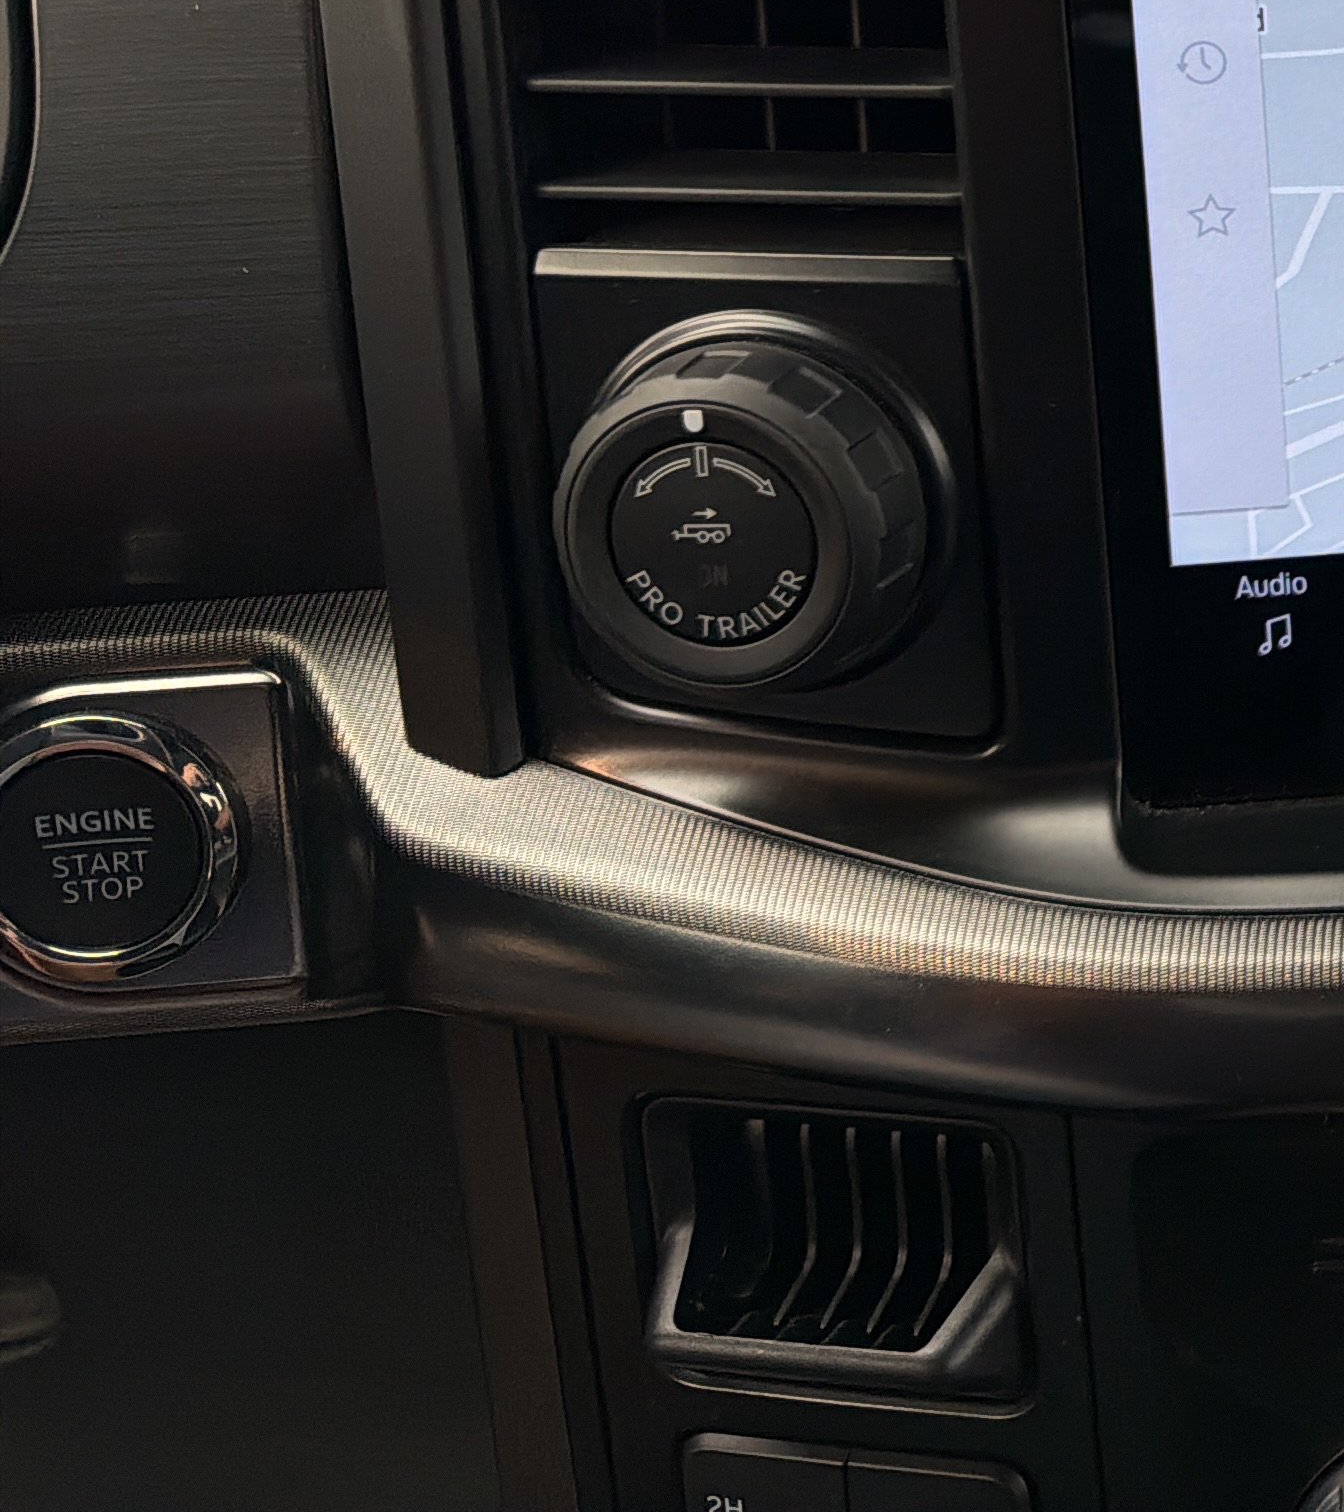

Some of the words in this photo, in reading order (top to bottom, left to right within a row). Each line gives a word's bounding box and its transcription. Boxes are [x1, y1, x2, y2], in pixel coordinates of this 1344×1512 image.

[1235, 571, 1308, 600] Audio
[626, 570, 683, 625] PRO
[696, 568, 806, 640] TRAILER
[34, 807, 155, 839] ENGINE
[51, 850, 149, 879] START
[62, 877, 144, 904] STOP
